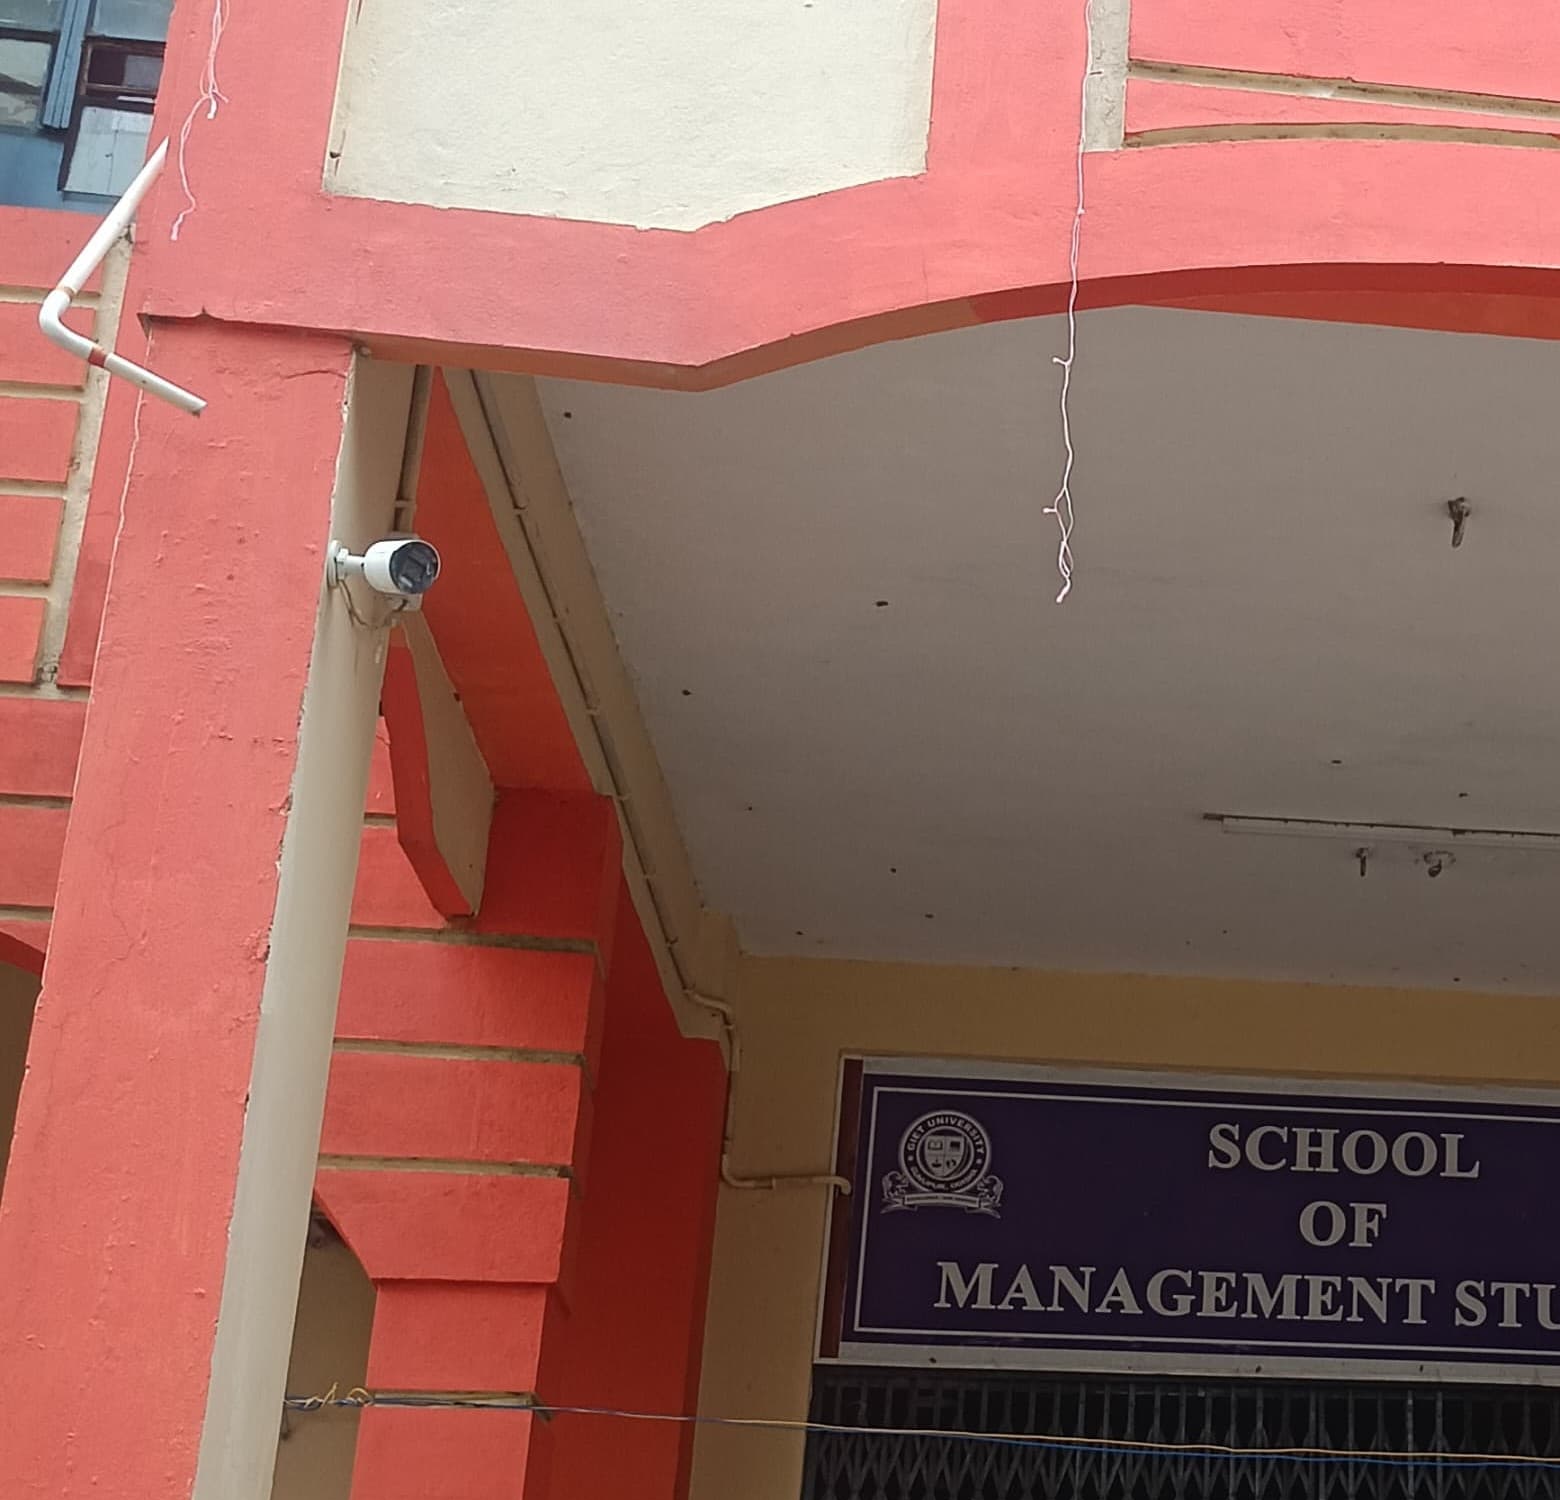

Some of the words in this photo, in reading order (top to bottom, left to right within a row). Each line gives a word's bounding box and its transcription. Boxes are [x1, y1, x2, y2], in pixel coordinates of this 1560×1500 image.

[907, 1125, 926, 1151] GIET
[927, 1117, 985, 1153] UNIVERSITY
[1208, 1123, 1480, 1178] SCHOOL
[1299, 1201, 1388, 1247] OF
[933, 1261, 1435, 1324] MANAGEMENT
